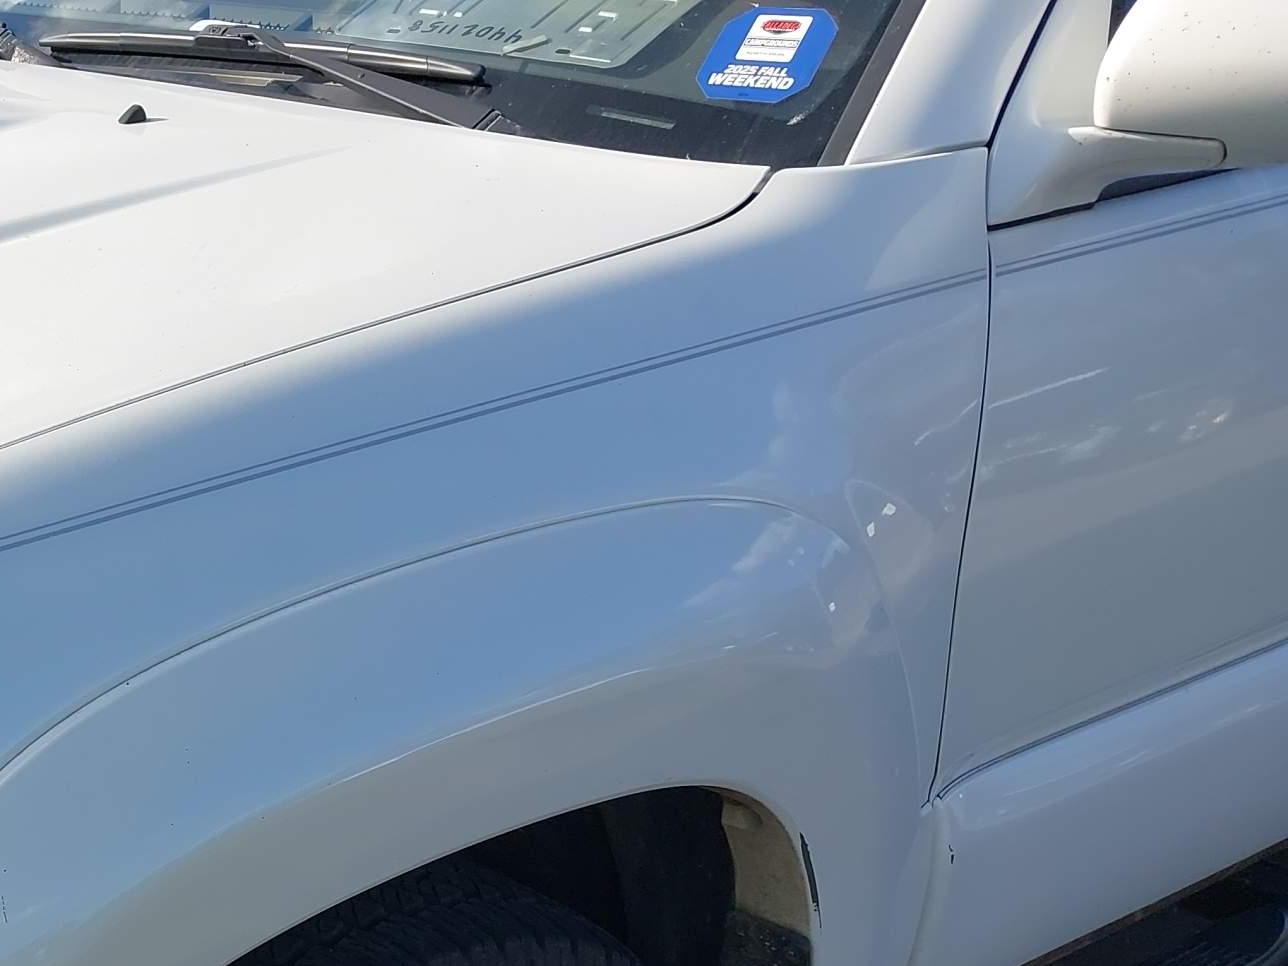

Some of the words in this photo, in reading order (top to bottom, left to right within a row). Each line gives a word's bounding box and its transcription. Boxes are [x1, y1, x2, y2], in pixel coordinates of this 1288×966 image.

[723, 64, 760, 75] 2025
[757, 66, 789, 77] FALL
[708, 72, 795, 90] WEEKEND
